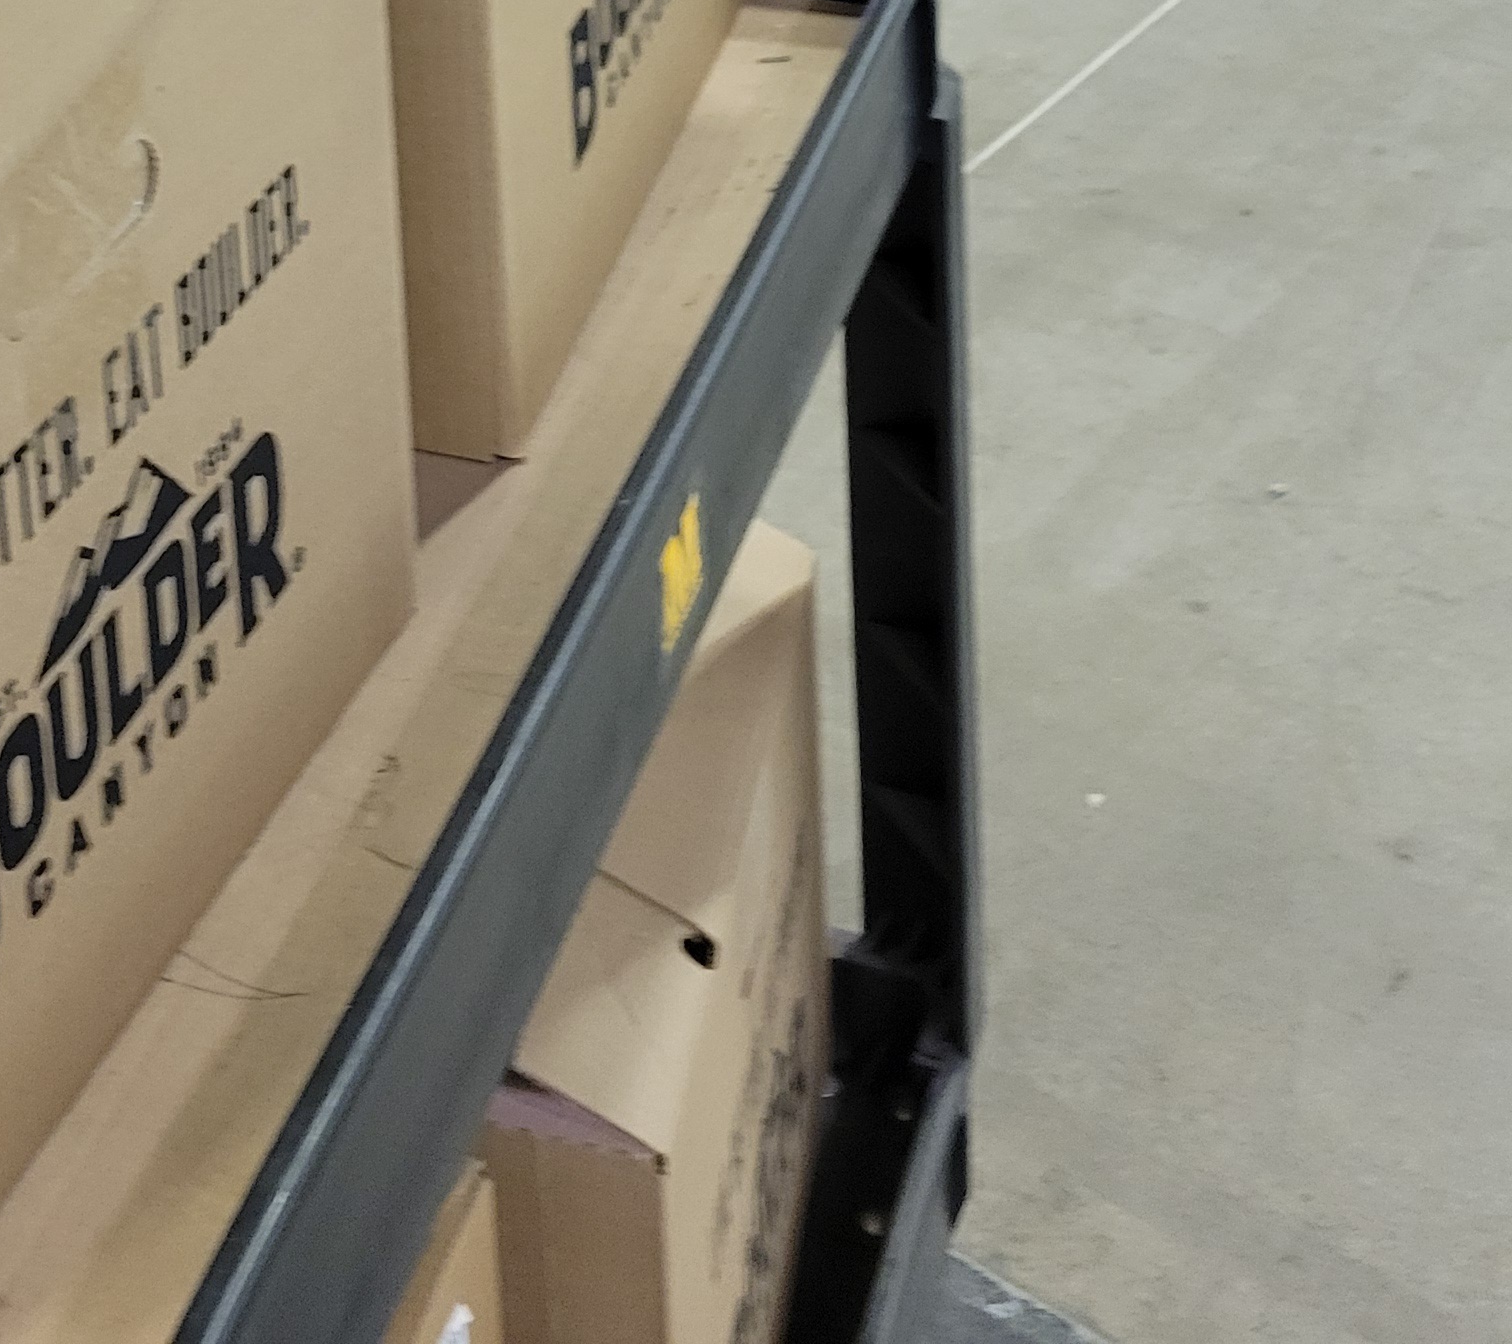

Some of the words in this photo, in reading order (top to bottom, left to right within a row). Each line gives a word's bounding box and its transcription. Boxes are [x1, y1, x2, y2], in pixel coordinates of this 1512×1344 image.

[101, 303, 166, 447] EAT
[173, 164, 311, 371] BOULDER.
[26, 642, 219, 918] CANYON
